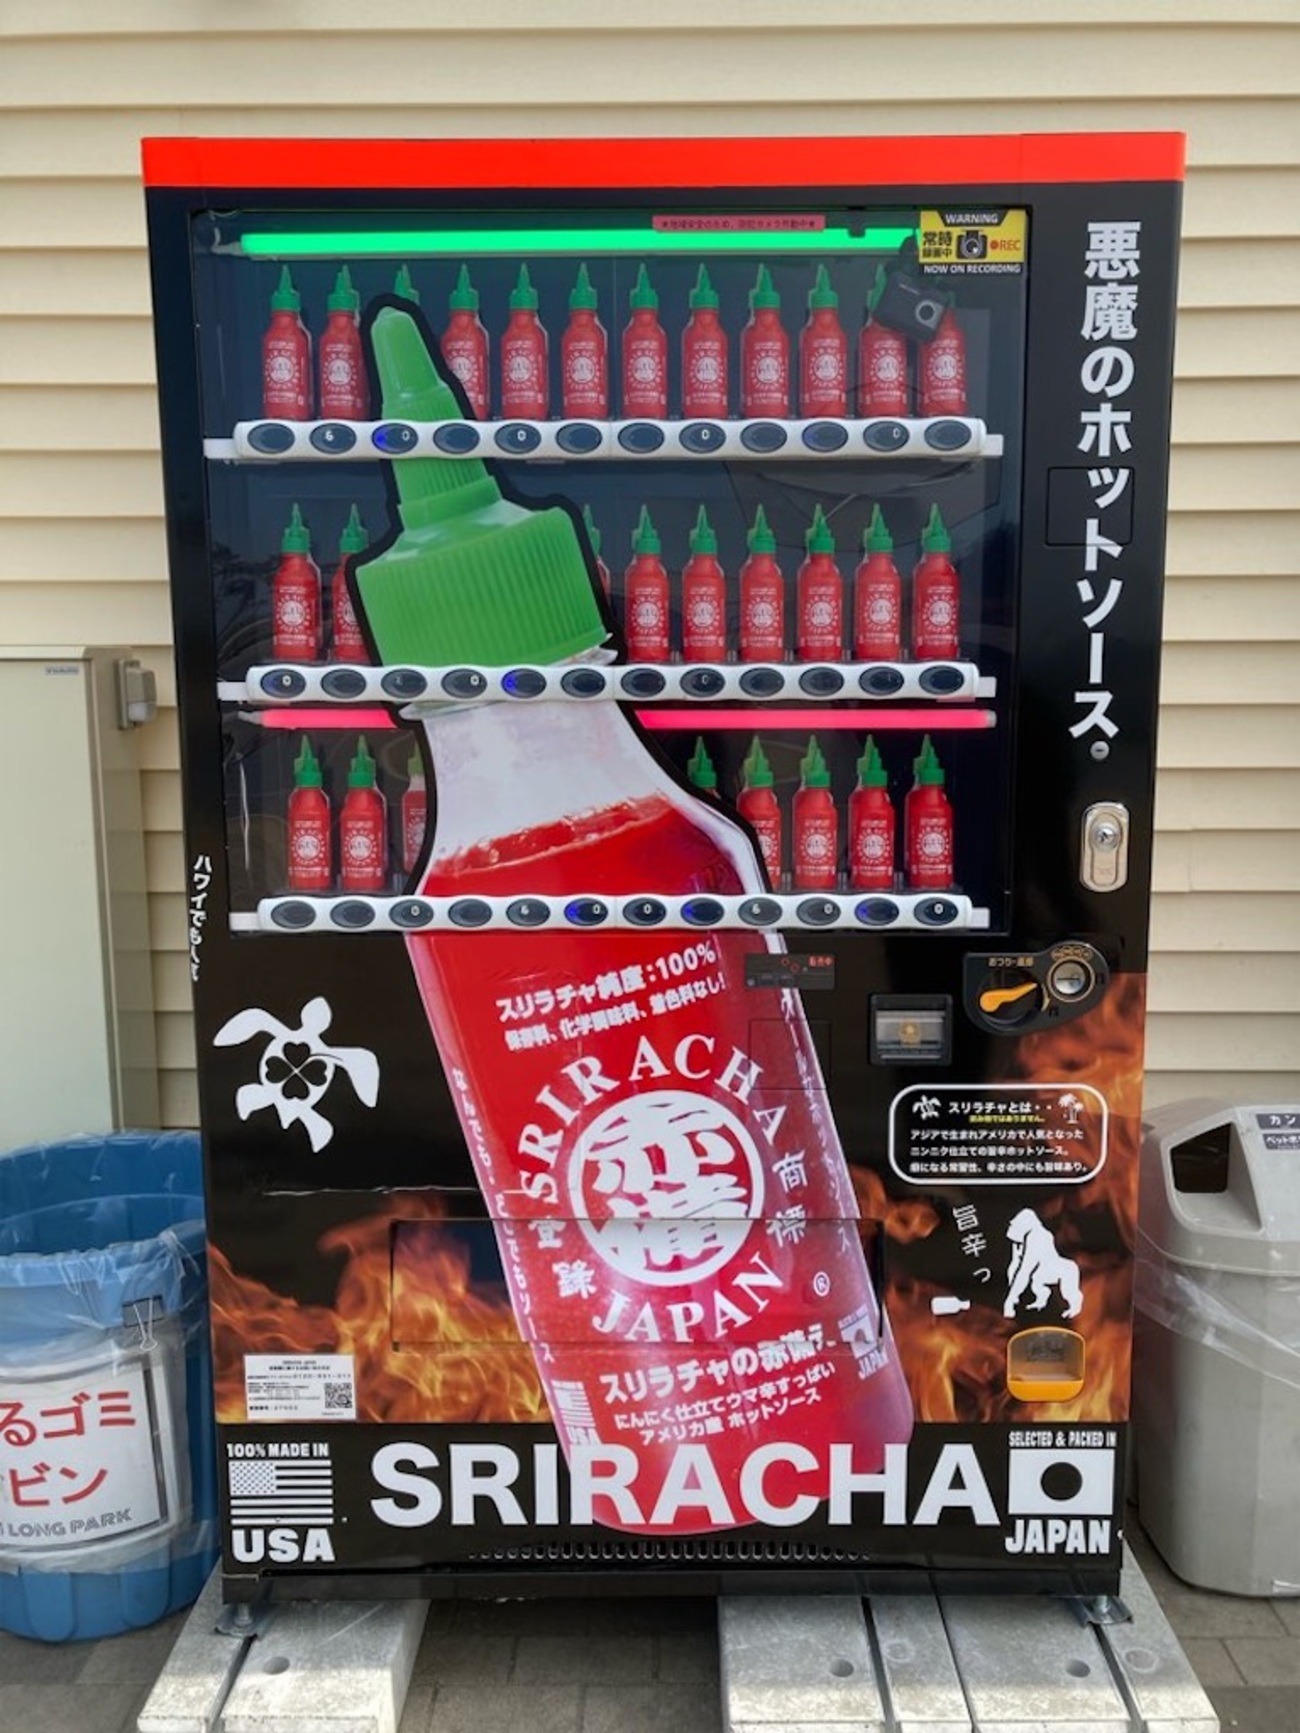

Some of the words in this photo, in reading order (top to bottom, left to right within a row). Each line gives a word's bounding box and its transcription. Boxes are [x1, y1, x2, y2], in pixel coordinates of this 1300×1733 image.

[945, 213, 999, 224] WARNING
[923, 231, 952, 246] 常時
[1000, 240, 1021, 251] REC
[924, 264, 948, 274] NOW
[950, 264, 965, 274] ON
[966, 264, 1021, 274] RECORDING
[519, 1033, 788, 1204] SRIRACHA
[592, 1251, 784, 1344] JAPAN
[728, 1387, 822, 1429] ホットソース
[227, 1443, 266, 1458] 100%
[268, 1443, 310, 1457] MADE
[313, 1442, 329, 1457] IN
[1009, 1431, 1053, 1447] SELECTED
[1055, 1431, 1066, 1447] &
[1068, 1431, 1104, 1447] PACKED
[1106, 1431, 1116, 1447] IN
[8, 1462, 108, 1507] ビン
[370, 1442, 1001, 1527] SRIRACHA
[8, 1522, 67, 1538] LONG
[70, 1508, 132, 1534] PARK
[1005, 1519, 1111, 1554] JAPAN
[231, 1528, 336, 1563] USA
